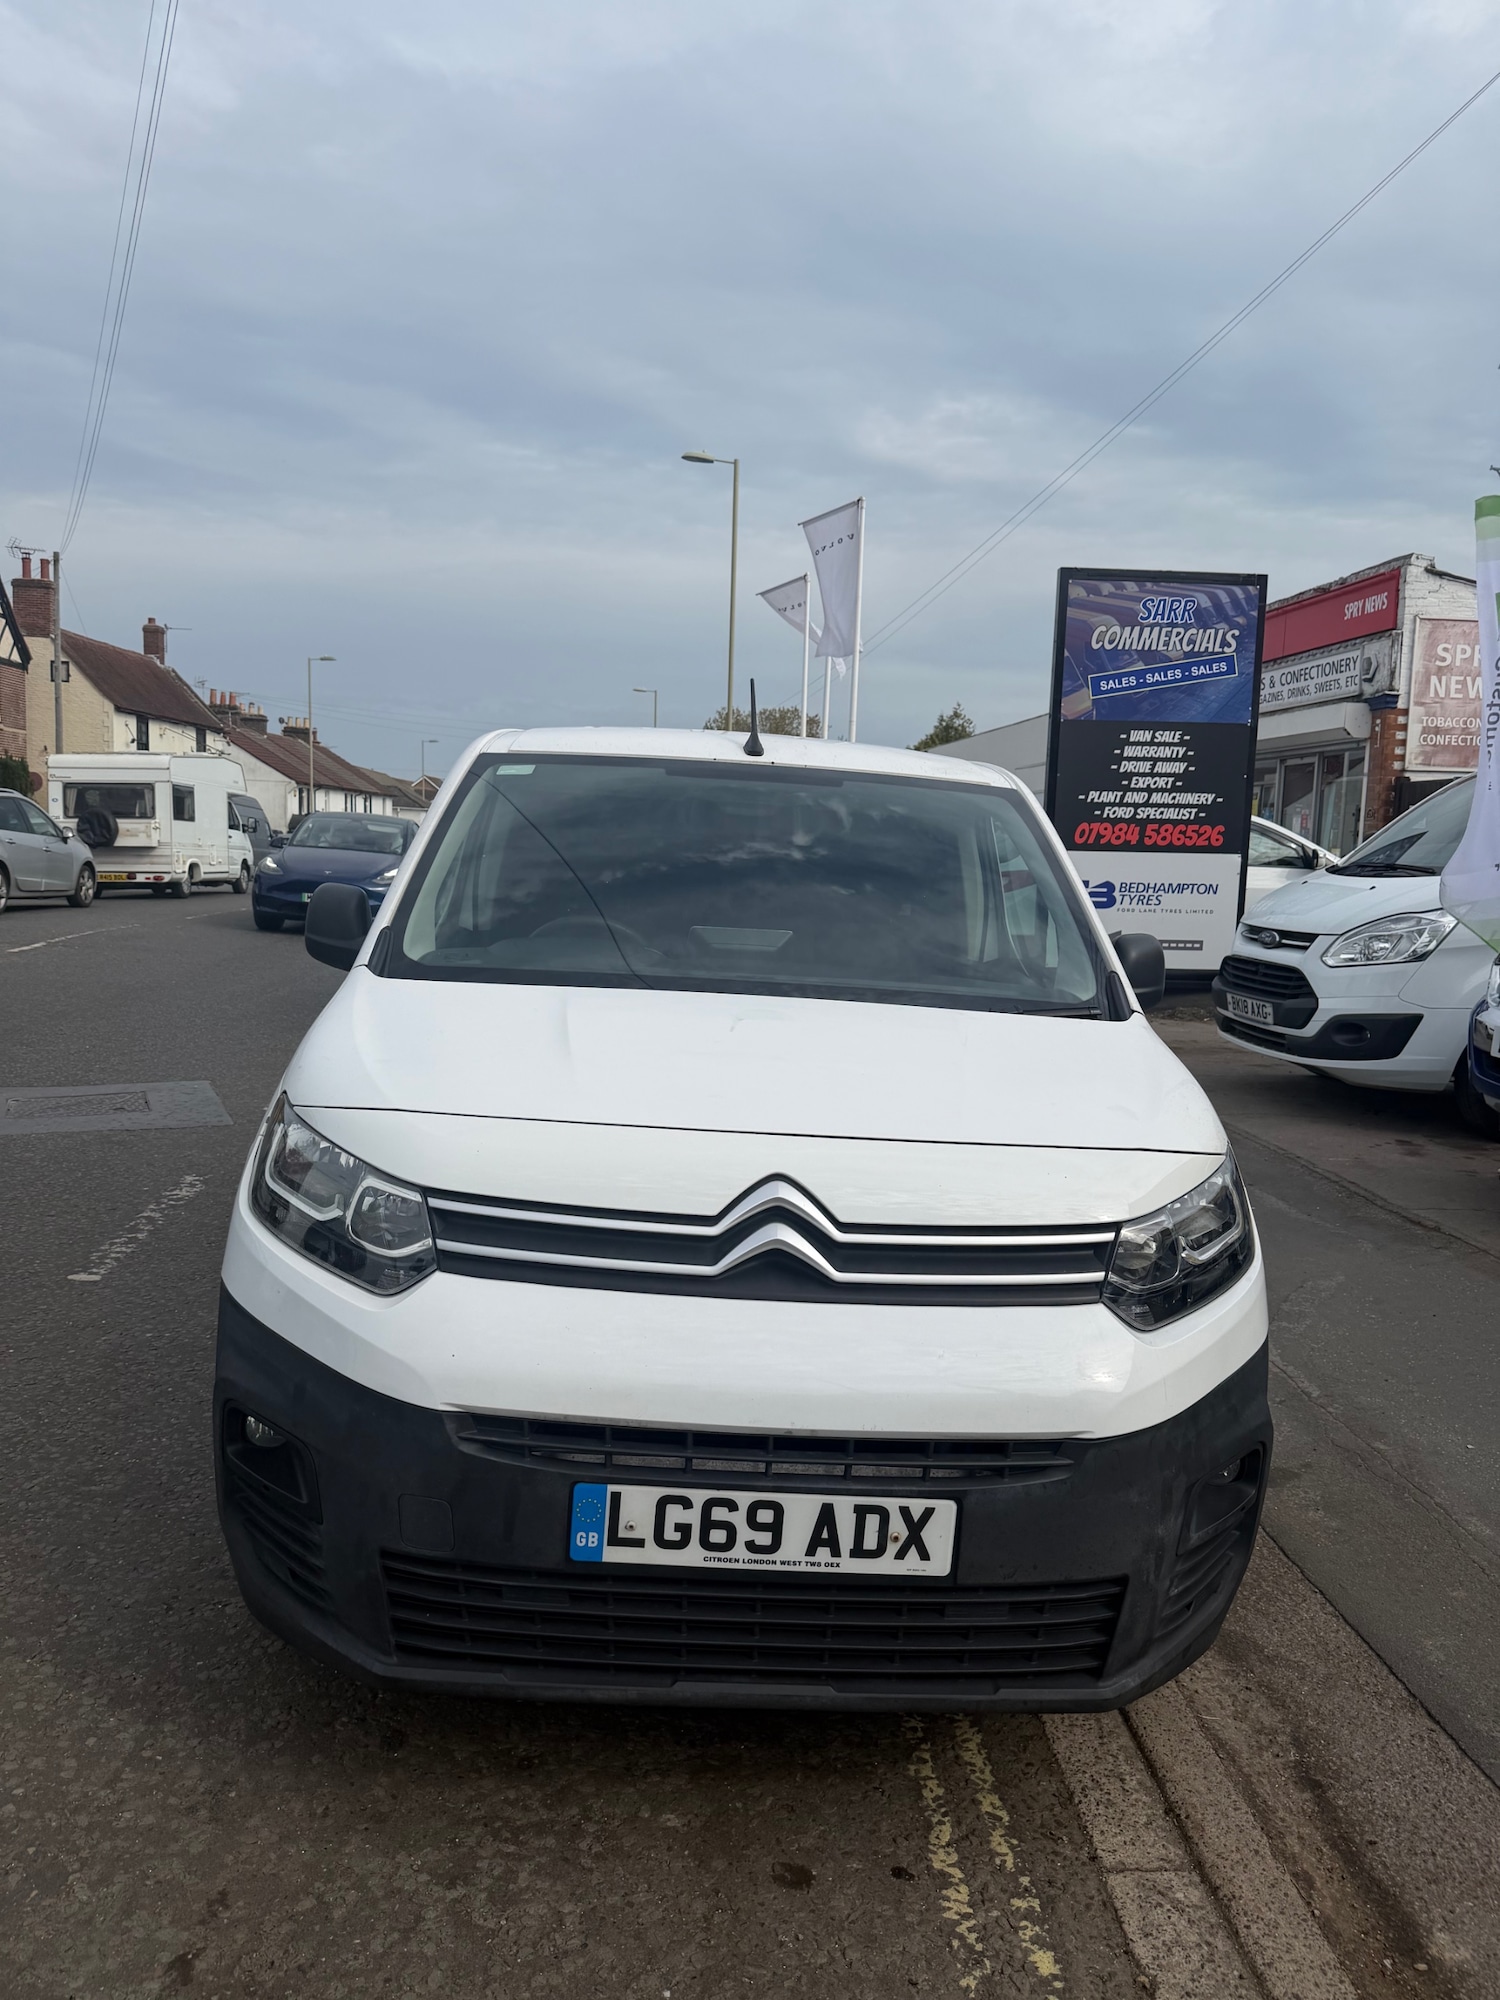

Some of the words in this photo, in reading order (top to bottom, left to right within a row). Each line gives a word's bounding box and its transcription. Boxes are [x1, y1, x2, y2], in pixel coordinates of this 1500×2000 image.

[1138, 596, 1197, 624] SARR
[1344, 599, 1364, 620] SPRY
[1364, 592, 1389, 614] NEWS
[1090, 624, 1240, 653] COMMERCIALS
[1100, 676, 1137, 691] SALES
[1145, 669, 1182, 684] SALES
[1191, 662, 1228, 677] SALES
[1269, 675, 1276, 689] &
[1279, 655, 1358, 687] CONFECTIONERY
[1287, 684, 1312, 700] DRINKS,
[1314, 678, 1343, 694] SWEETS,
[1345, 674, 1359, 688] ETC
[1129, 730, 1153, 742] VAN
[1153, 731, 1182, 743] SALE
[1122, 745, 1186, 758] WARRANTY
[1119, 761, 1153, 773] DRIVE
[1153, 761, 1187, 774] AWAY
[1130, 776, 1174, 789] EXPORT
[1087, 791, 1123, 803] PLANT
[1123, 792, 1150, 804] AND
[1150, 792, 1215, 805] MACHINERY
[1103, 807, 1134, 819] FORD
[1136, 807, 1198, 820] SPECIALIST
[1074, 822, 1140, 845] 07984
[1143, 823, 1226, 847] 586526
[1119, 882, 1219, 895] BEDHAMPTON
[1119, 894, 1163, 906] TYRES
[1231, 995, 1249, 1015] BK18
[1250, 1001, 1268, 1020] AXG
[606, 1490, 785, 1556] LG69
[804, 1501, 936, 1562] ADX
[575, 1531, 599, 1548] GB
[703, 1556, 740, 1564] CITROEN
[742, 1557, 777, 1566] LONDON
[779, 1559, 803, 1567] WEST
